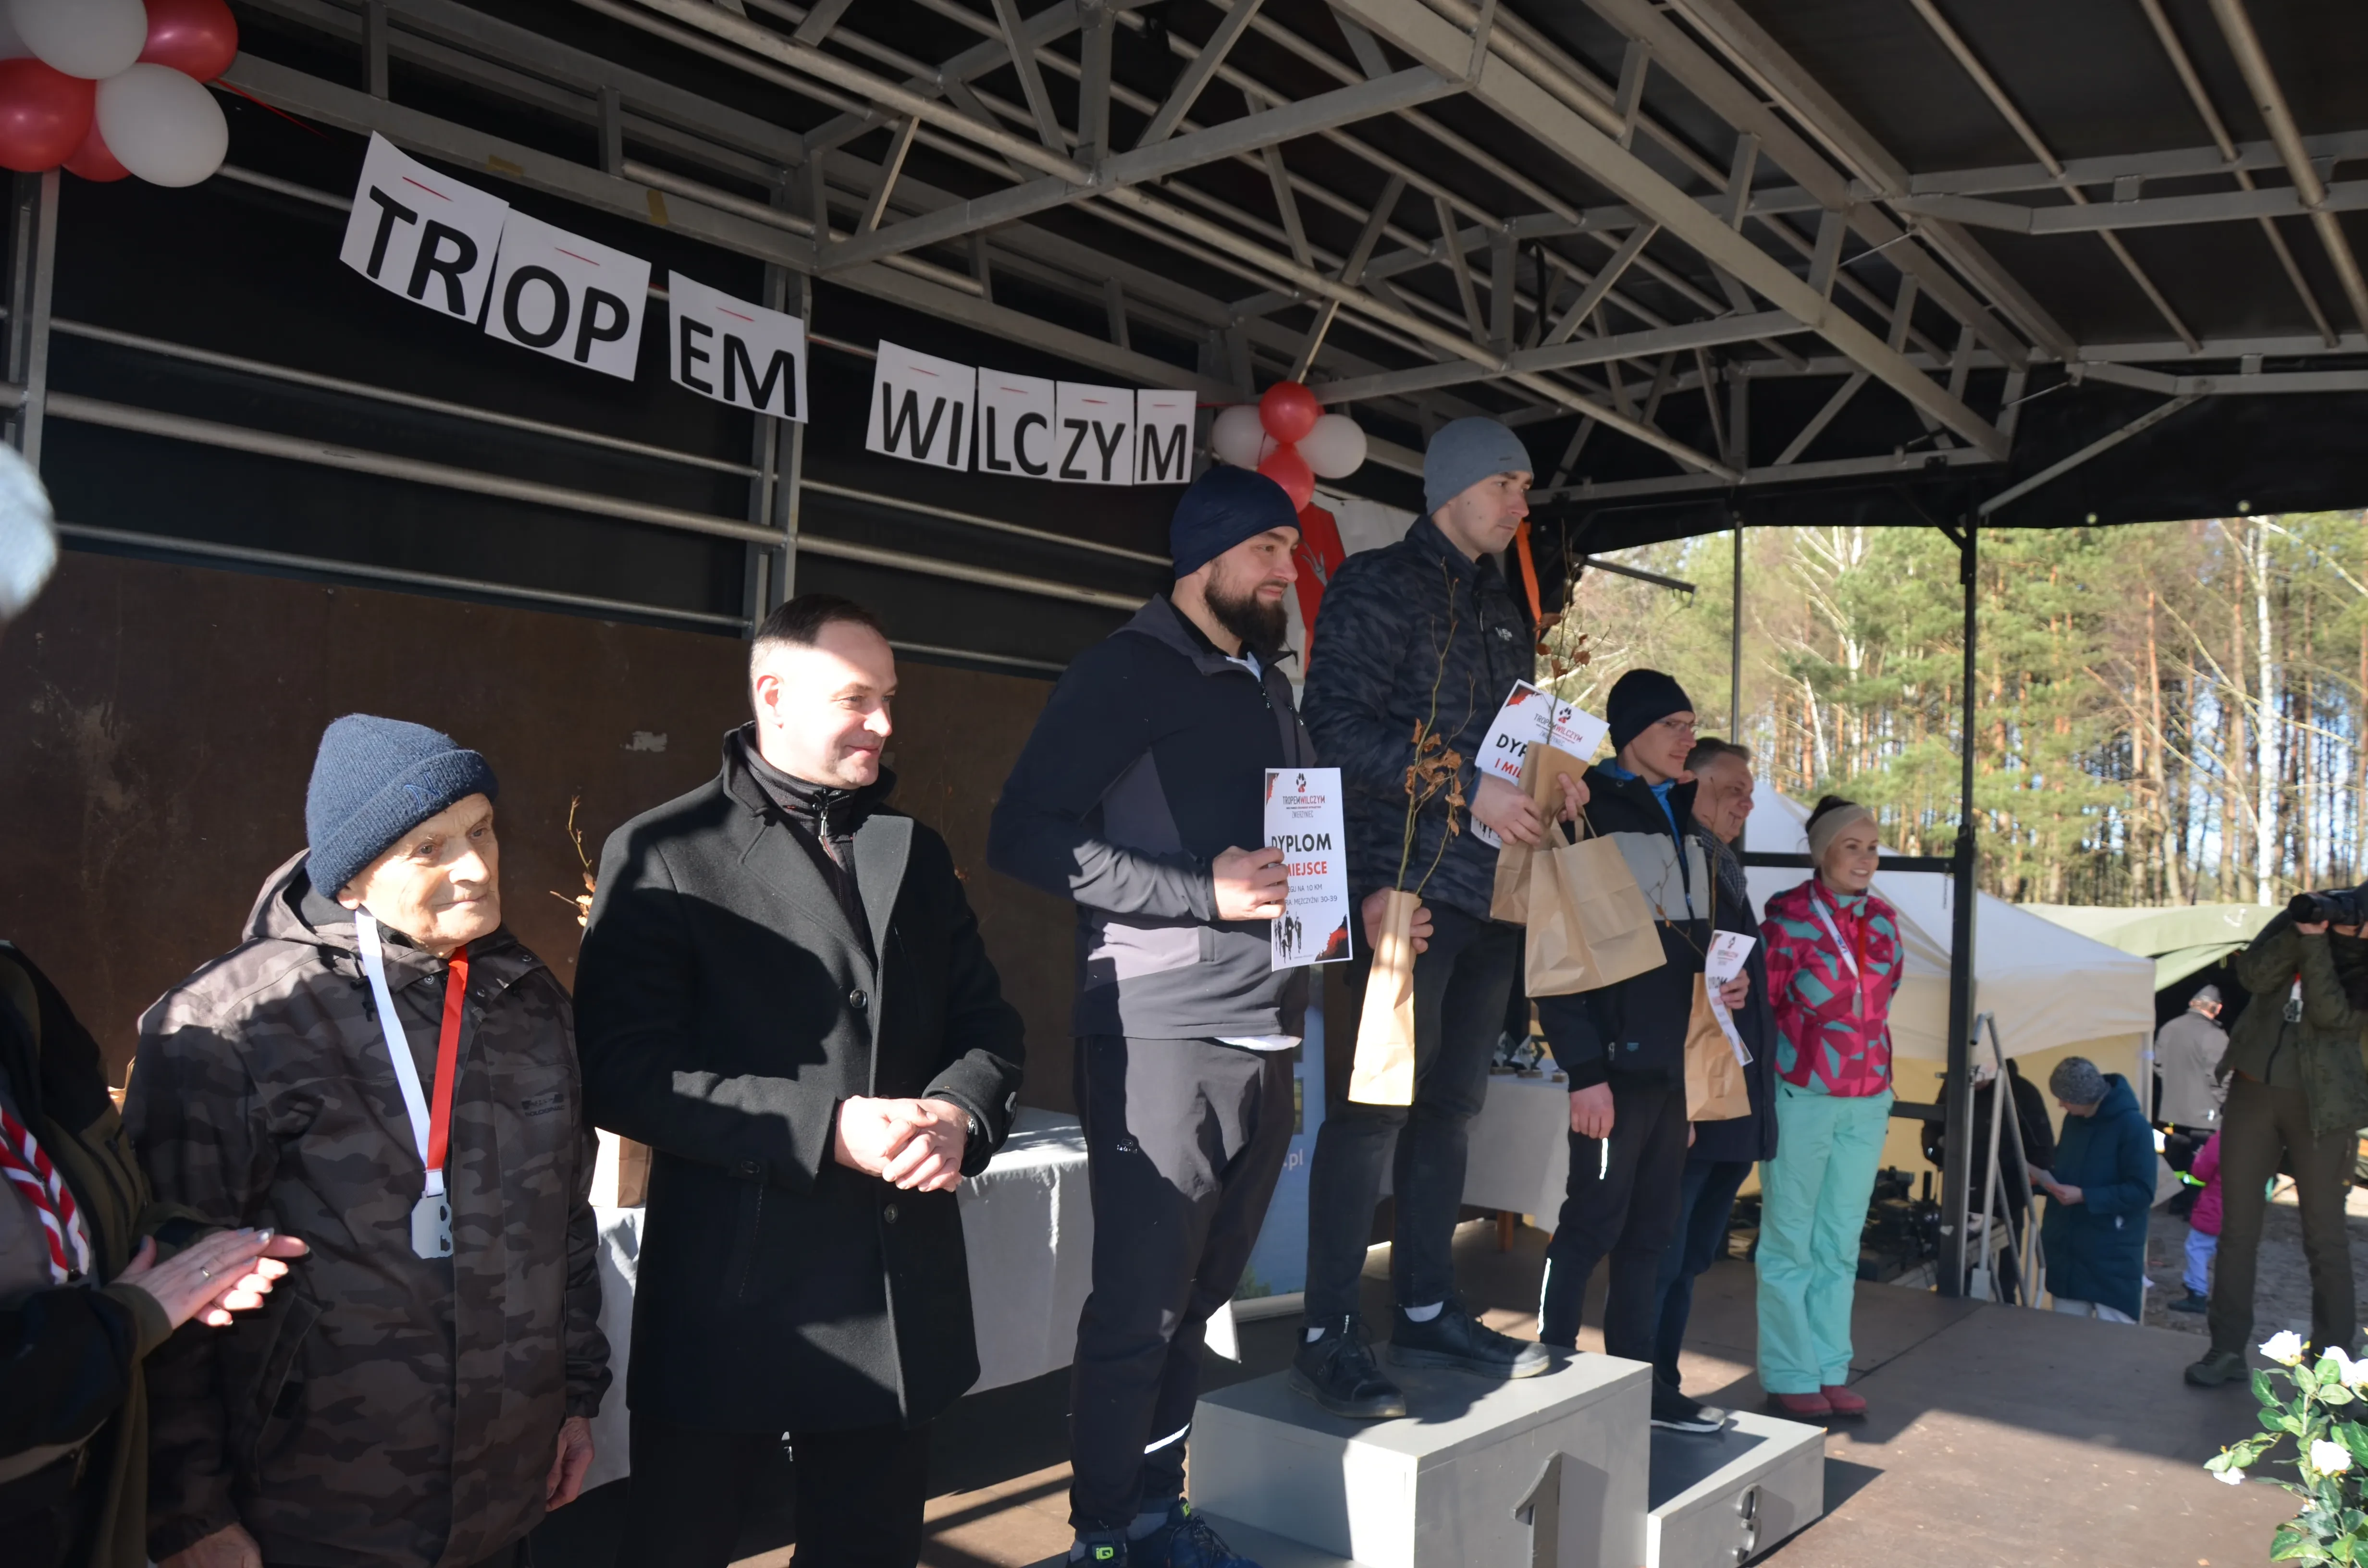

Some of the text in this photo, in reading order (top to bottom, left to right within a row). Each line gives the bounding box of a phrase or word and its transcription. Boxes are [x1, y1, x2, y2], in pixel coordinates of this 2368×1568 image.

[882, 381, 1187, 482] WILCZYM
[1283, 795, 1325, 805] TROPEMWILCZYM
[1271, 833, 1332, 853] DYPLOM
